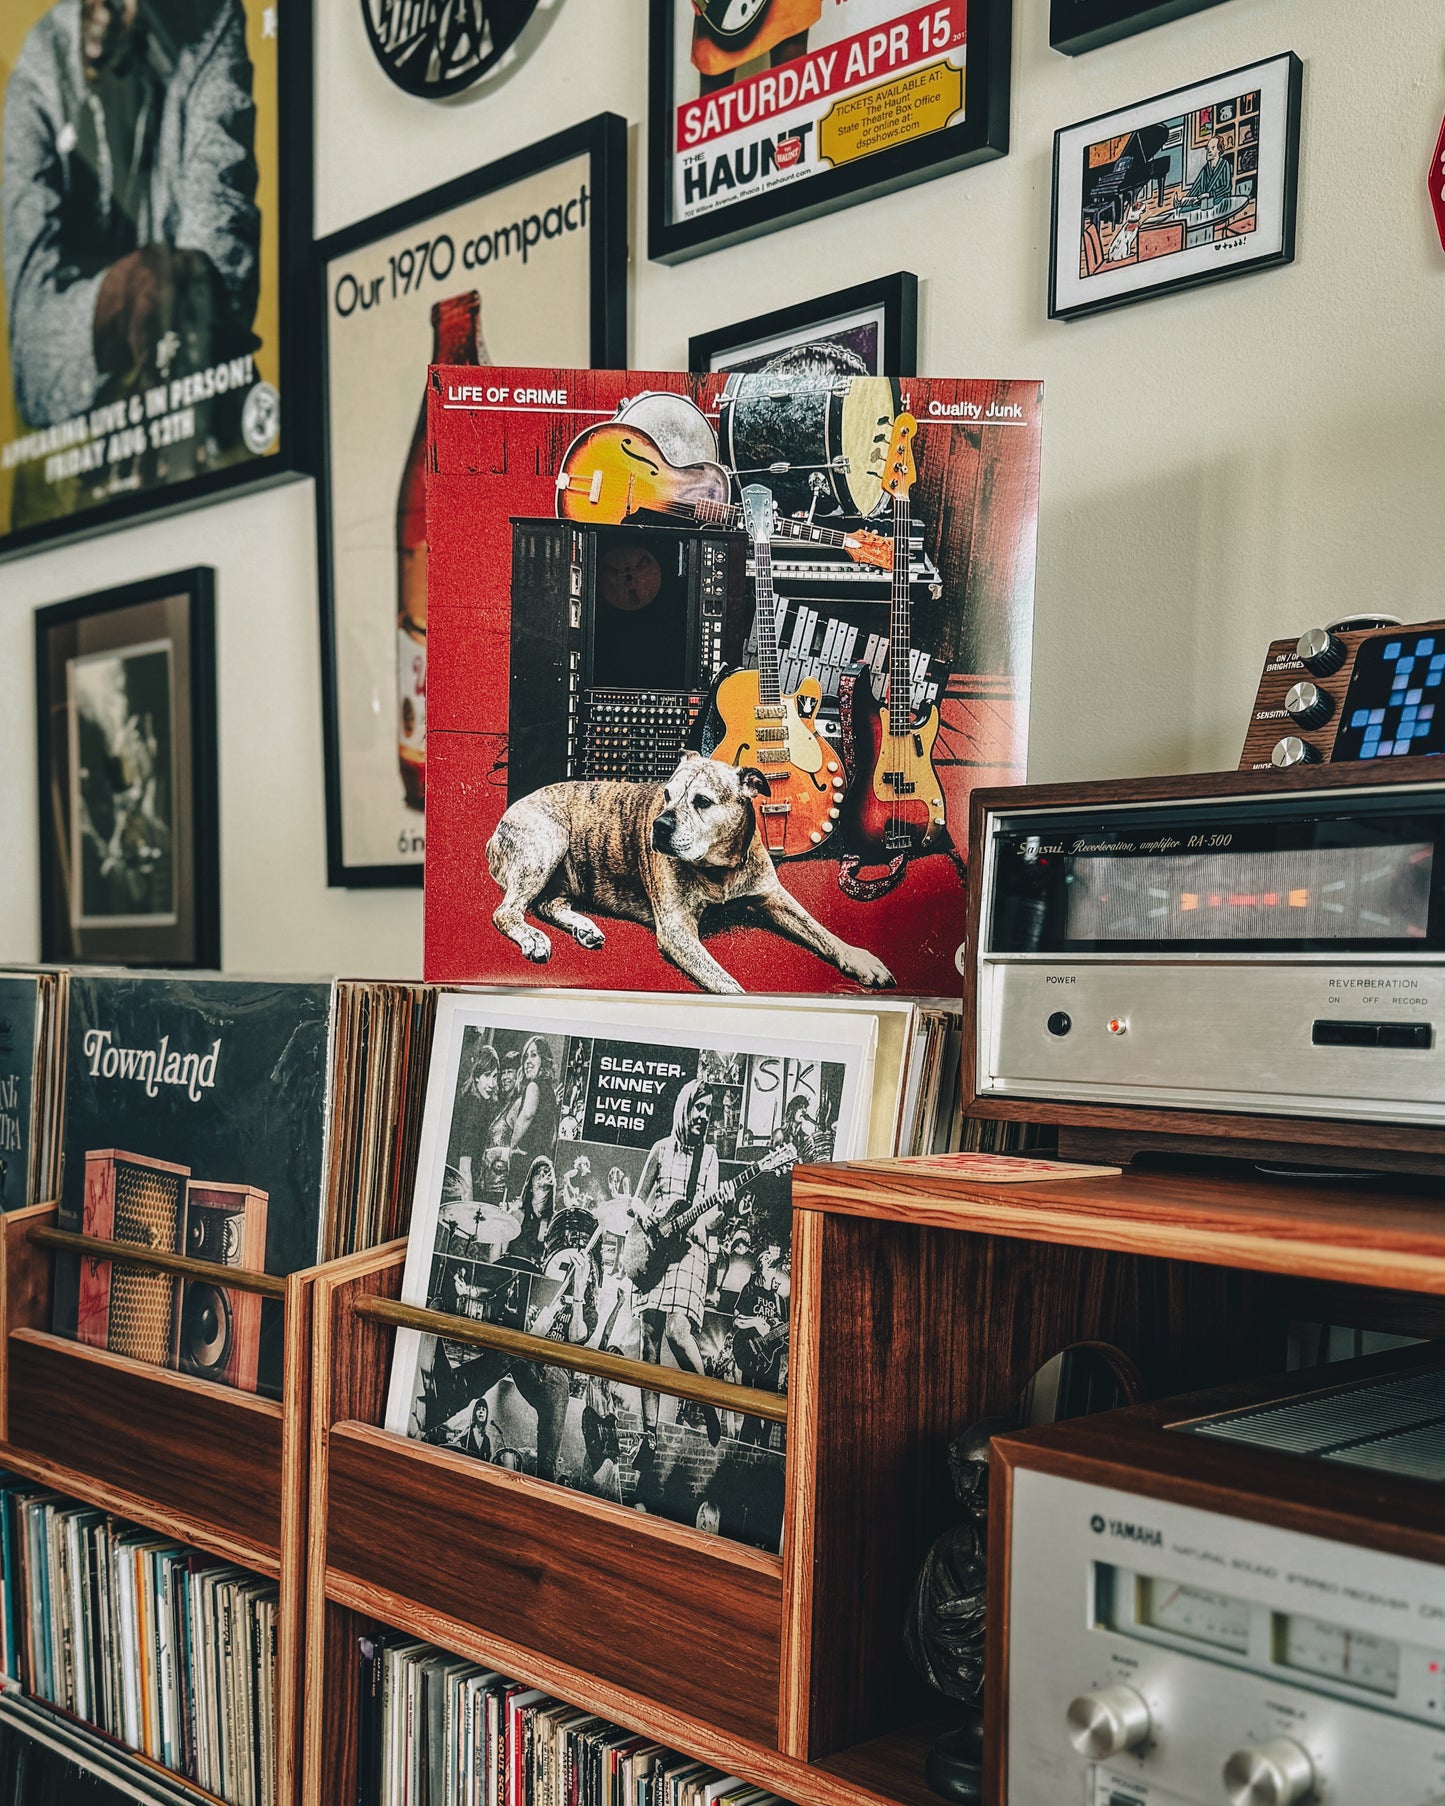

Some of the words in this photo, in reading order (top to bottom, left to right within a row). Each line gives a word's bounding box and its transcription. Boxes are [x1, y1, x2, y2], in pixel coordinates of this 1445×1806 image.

[684, 51, 838, 144] SATURDAY
[844, 23, 909, 84] APR
[918, 7, 951, 53] 15
[836, 96, 873, 117] TICKETS
[875, 75, 926, 102] AVAILABLE
[928, 70, 943, 83] AT:
[866, 102, 882, 115] The
[884, 93, 911, 111] Haunt
[837, 121, 859, 136] State
[861, 108, 894, 127] Theatre
[895, 102, 912, 116] Box
[914, 93, 941, 109] Office
[862, 128, 872, 137] or
[873, 118, 900, 132] online
[902, 113, 913, 124] at:
[856, 120, 920, 149] dspshows.com
[683, 152, 705, 166] THE
[684, 121, 813, 206] HAUNT
[335, 274, 385, 317] Our
[389, 234, 455, 299] 1970
[463, 184, 591, 265] compact
[90, 400, 128, 441] LIVE
[145, 385, 168, 418] IN
[170, 354, 254, 410] PERSON!
[448, 386, 483, 402] LIFE
[486, 387, 510, 403] OF
[513, 388, 567, 405] GRIME
[928, 400, 982, 420] Quality
[986, 401, 1022, 418] Junk
[45, 439, 107, 484] FRIDAY
[107, 424, 147, 465] AUG
[150, 408, 195, 449] 12TH
[1276, 654, 1287, 662] ON
[1068, 839, 1136, 855] Reverberation
[1140, 837, 1181, 852] amplifier
[1187, 834, 1233, 848] RA-500
[1046, 976, 1076, 984] POWER
[1328, 979, 1418, 988] REVERBERATION
[1328, 996, 1340, 1004] ON
[1392, 997, 1428, 1005] RECORD
[83, 1029, 222, 1102] Townland
[600, 1056, 687, 1078] SLEATER-
[598, 1075, 667, 1095] KINNEY
[596, 1096, 631, 1112] LIVE
[636, 1101, 654, 1115] IN
[594, 1113, 645, 1131] PARIS
[1109, 1520, 1163, 1548] YAMAHA
